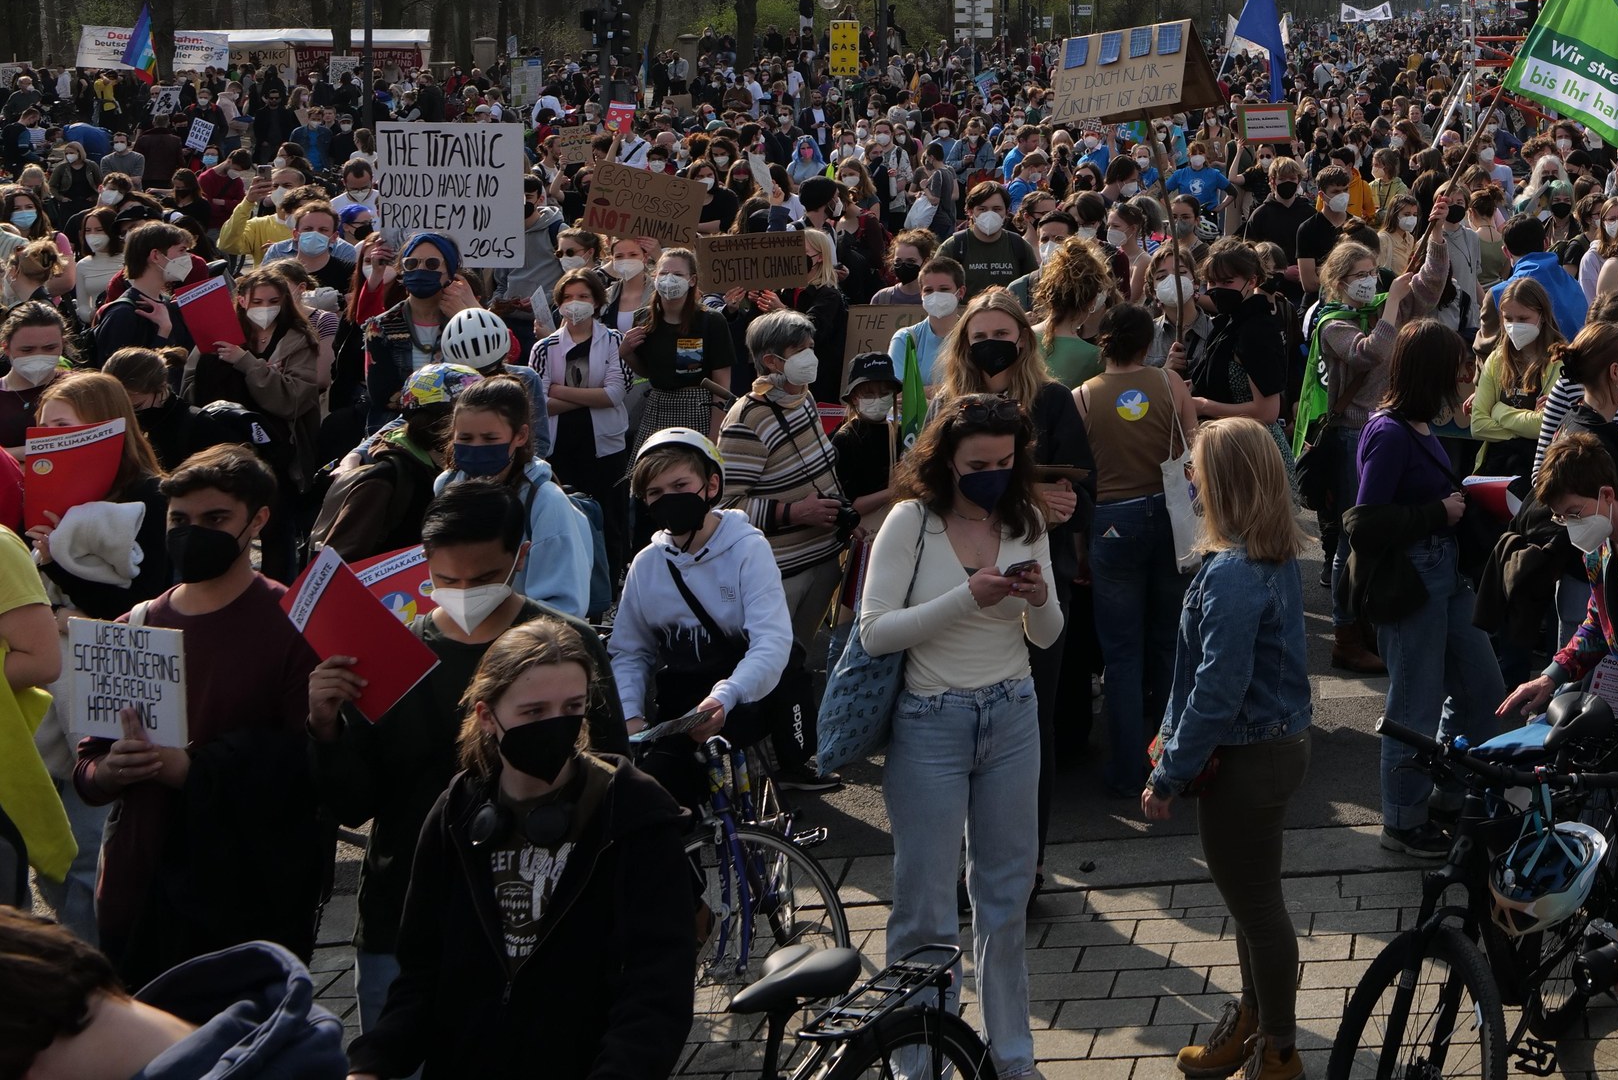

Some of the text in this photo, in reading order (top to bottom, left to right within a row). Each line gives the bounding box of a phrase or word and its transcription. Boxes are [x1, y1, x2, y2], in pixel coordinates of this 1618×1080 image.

[832, 22, 857, 30] OIL
[831, 43, 857, 51] GAS
[1551, 40, 1585, 66] Wir
[831, 66, 857, 74] WAR
[1084, 71, 1119, 89] DOCH
[1123, 64, 1159, 84] KLAR
[1529, 66, 1556, 90] bis
[1561, 79, 1590, 103] Ihr
[1054, 83, 1177, 121] ZUKUNFT IST SOLAR
[189, 131, 209, 144] OBEN
[192, 126, 212, 137] NACH
[195, 120, 214, 130] SCHAU
[563, 127, 590, 135] SPREAD
[380, 130, 419, 167] THE
[560, 134, 591, 147] LOVE
[379, 172, 499, 198] WOULD HAVE NO
[597, 164, 653, 190] EAT
[615, 189, 691, 219] PUSSY
[381, 203, 491, 231] PROBLEM IN
[588, 207, 691, 244] NOT ANIMALS
[464, 237, 516, 259] 2045
[709, 235, 803, 253] CLIMATE CHANGE
[712, 255, 804, 284] SYSTEM CHANGE
[191, 283, 219, 298] KLIMAKARTE
[855, 314, 889, 330] THE
[31, 428, 113, 451] ROTE KLIMAKARTE
[295, 606, 308, 626] ROTE
[303, 562, 332, 606] KLIMAKARTE
[96, 624, 151, 649] WE'RE NOT
[74, 643, 180, 683] SCAREMONGERING
[90, 673, 162, 701] THIS IS REALLY
[88, 695, 157, 730] HAPPNING
